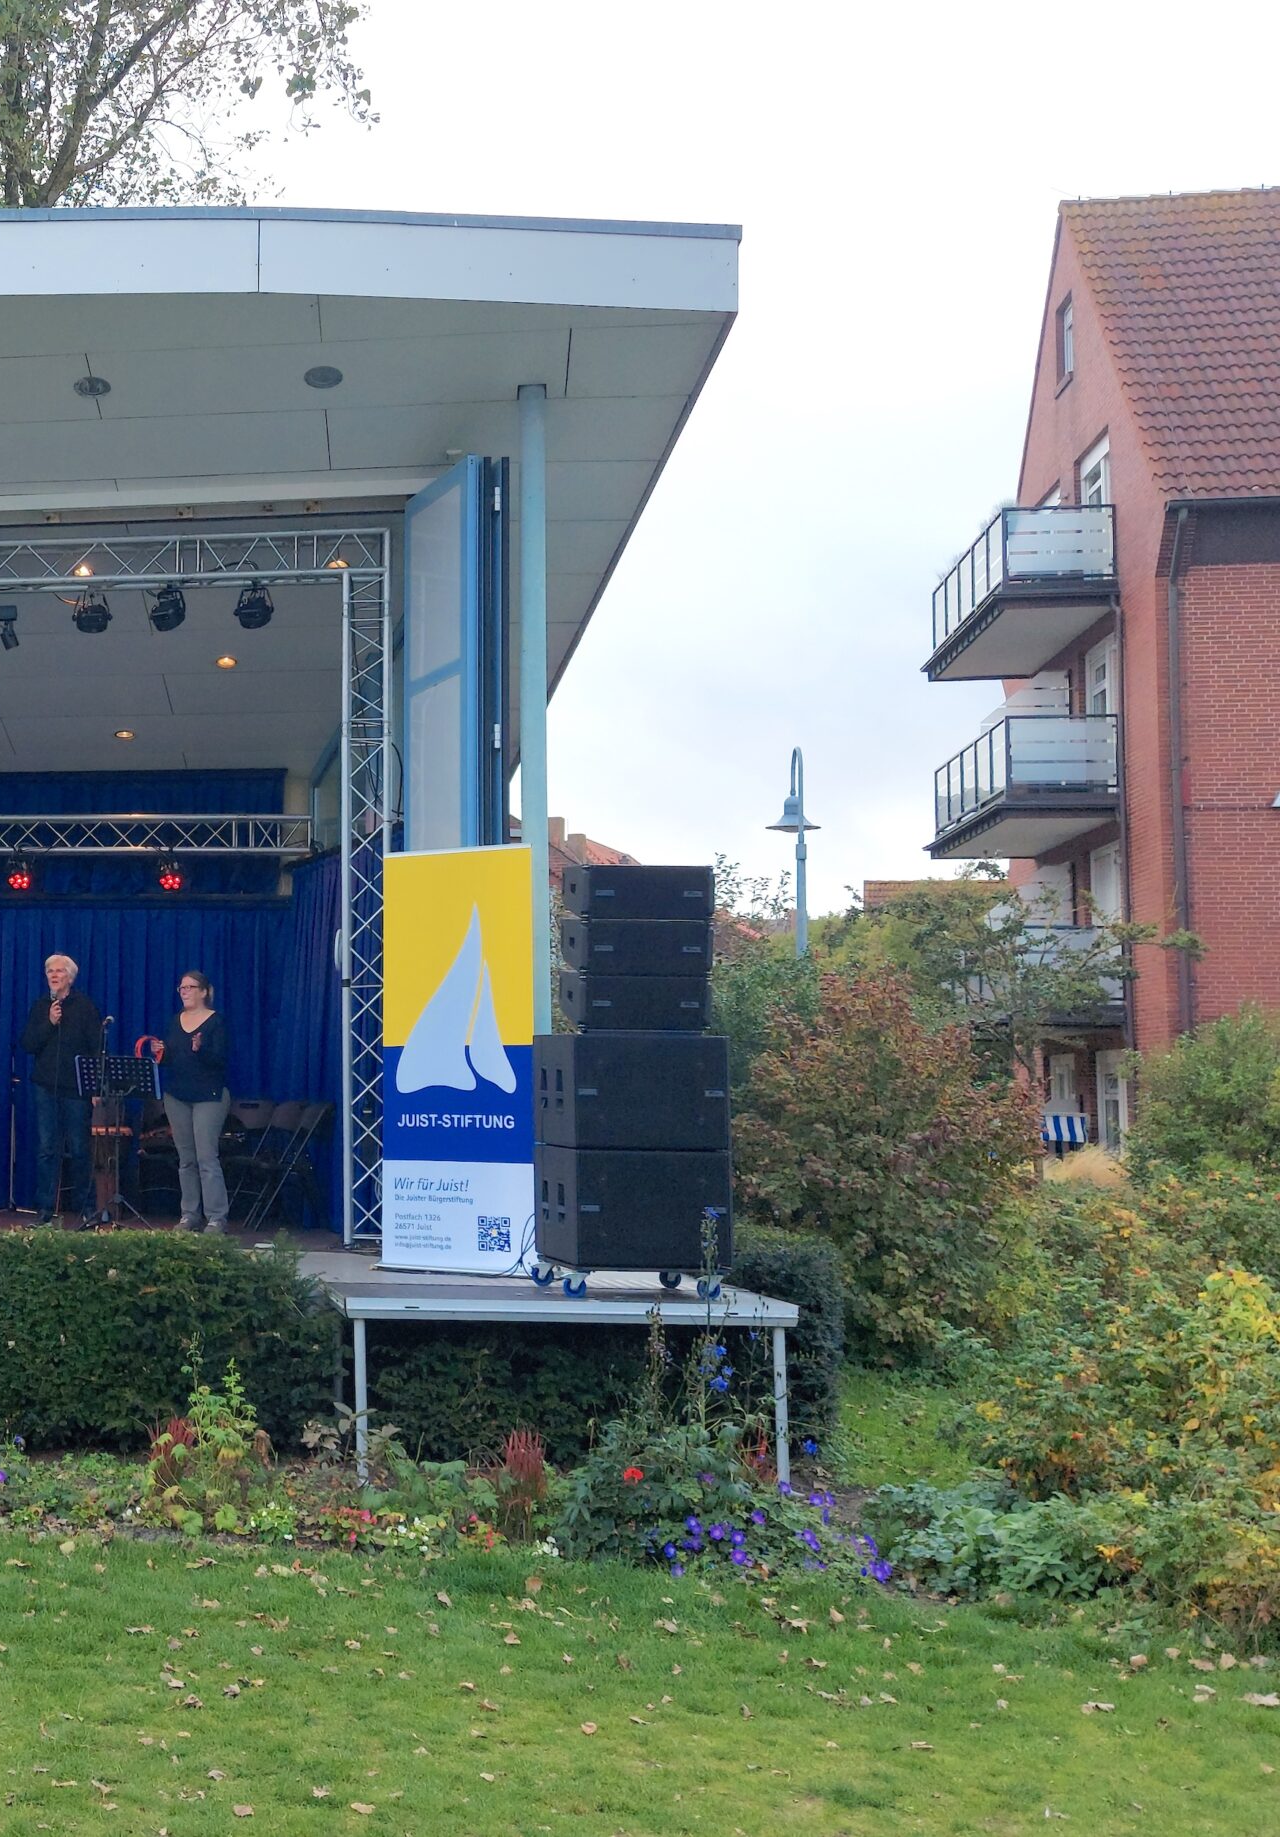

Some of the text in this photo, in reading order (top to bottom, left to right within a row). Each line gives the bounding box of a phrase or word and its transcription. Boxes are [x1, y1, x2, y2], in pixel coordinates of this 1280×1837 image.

[397, 1113, 515, 1129] JUIST-STIFTUNG
[394, 1177, 470, 1192] Wir für Juist!
[406, 1194, 427, 1202] Juister
[428, 1195, 474, 1205] Bürgerstiftung
[394, 1213, 441, 1222] Postfach 1326
[394, 1222, 433, 1231] 26571 Juist
